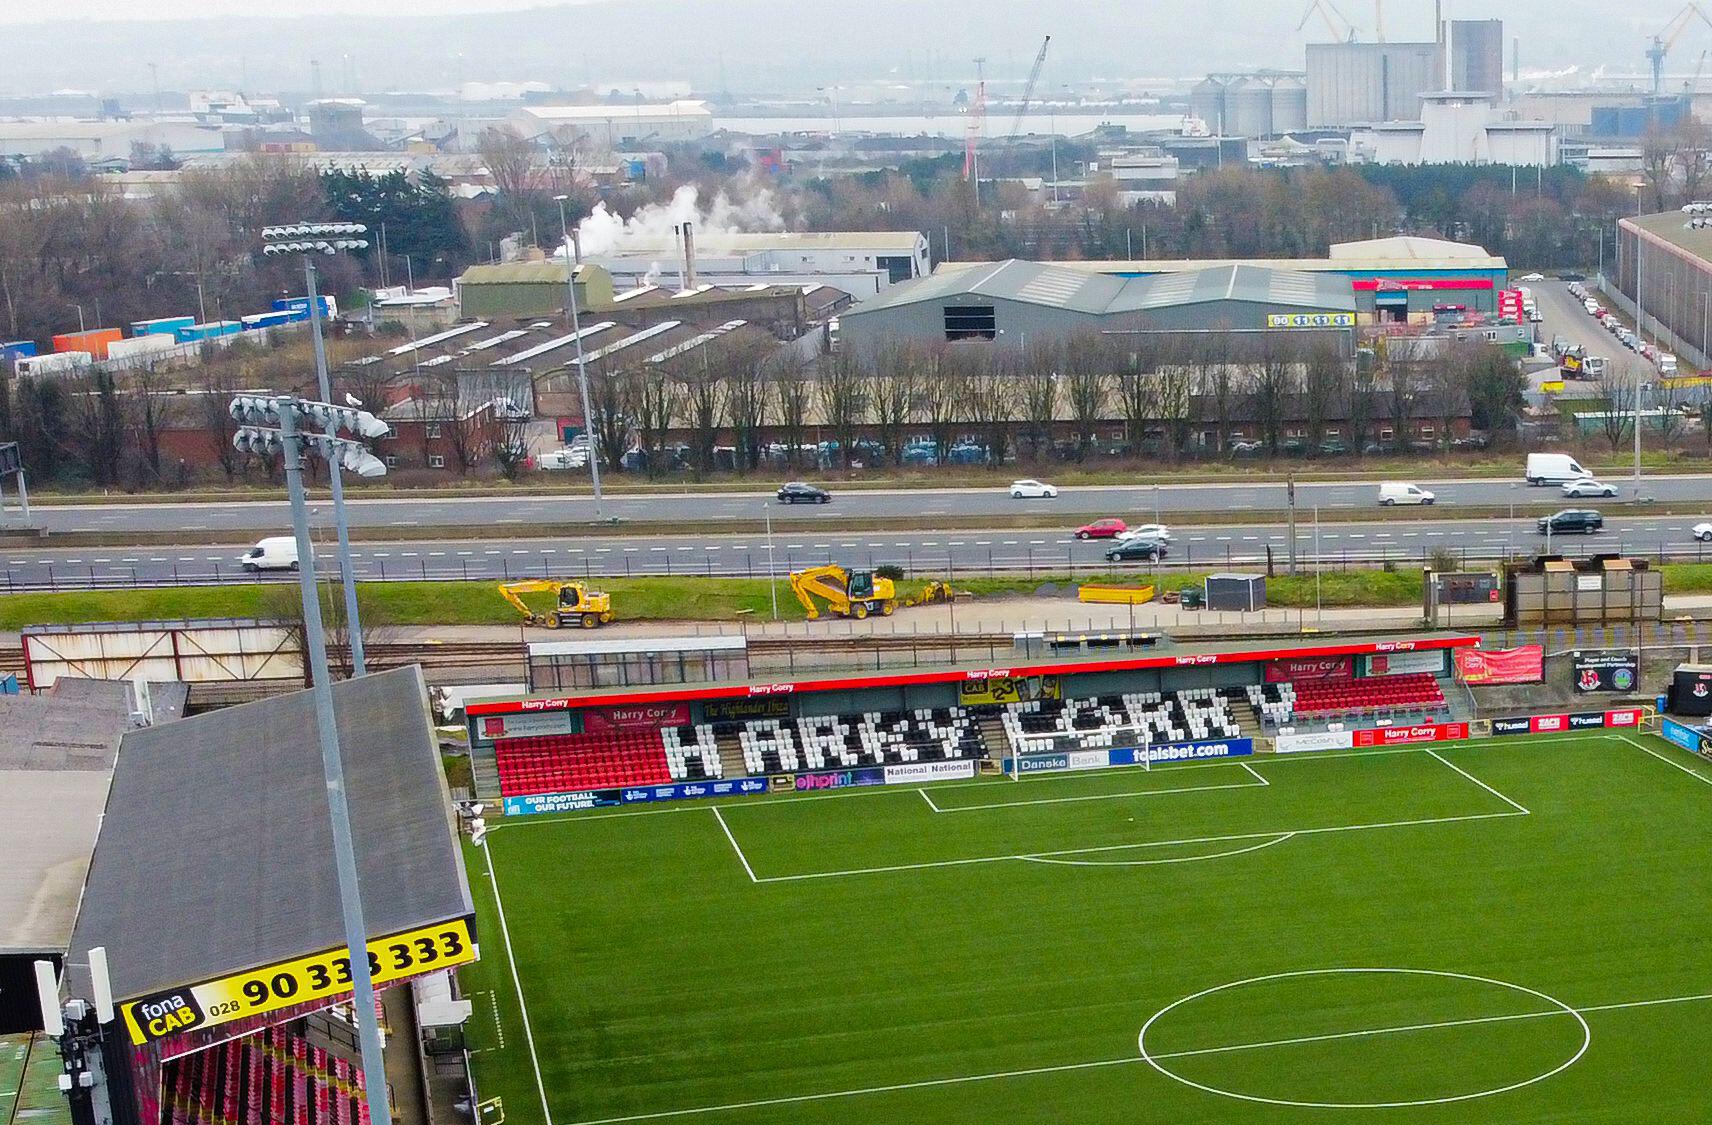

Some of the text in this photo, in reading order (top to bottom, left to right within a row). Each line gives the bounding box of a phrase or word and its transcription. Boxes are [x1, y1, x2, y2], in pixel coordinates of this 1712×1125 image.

[1290, 662, 1318, 673] Harry
[613, 709, 644, 721] Harry
[1385, 728, 1410, 739] Harry
[1133, 743, 1229, 763] toalsbet.com
[887, 762, 971, 777] National National
[1022, 758, 1066, 770] Danske
[525, 795, 548, 805] OUR
[535, 802, 556, 812] OUR
[209, 1000, 242, 1019] 028
[242, 973, 300, 1008] 90
[388, 931, 465, 971] 333
[141, 994, 185, 1022] fona
[149, 1007, 198, 1038] CAB
